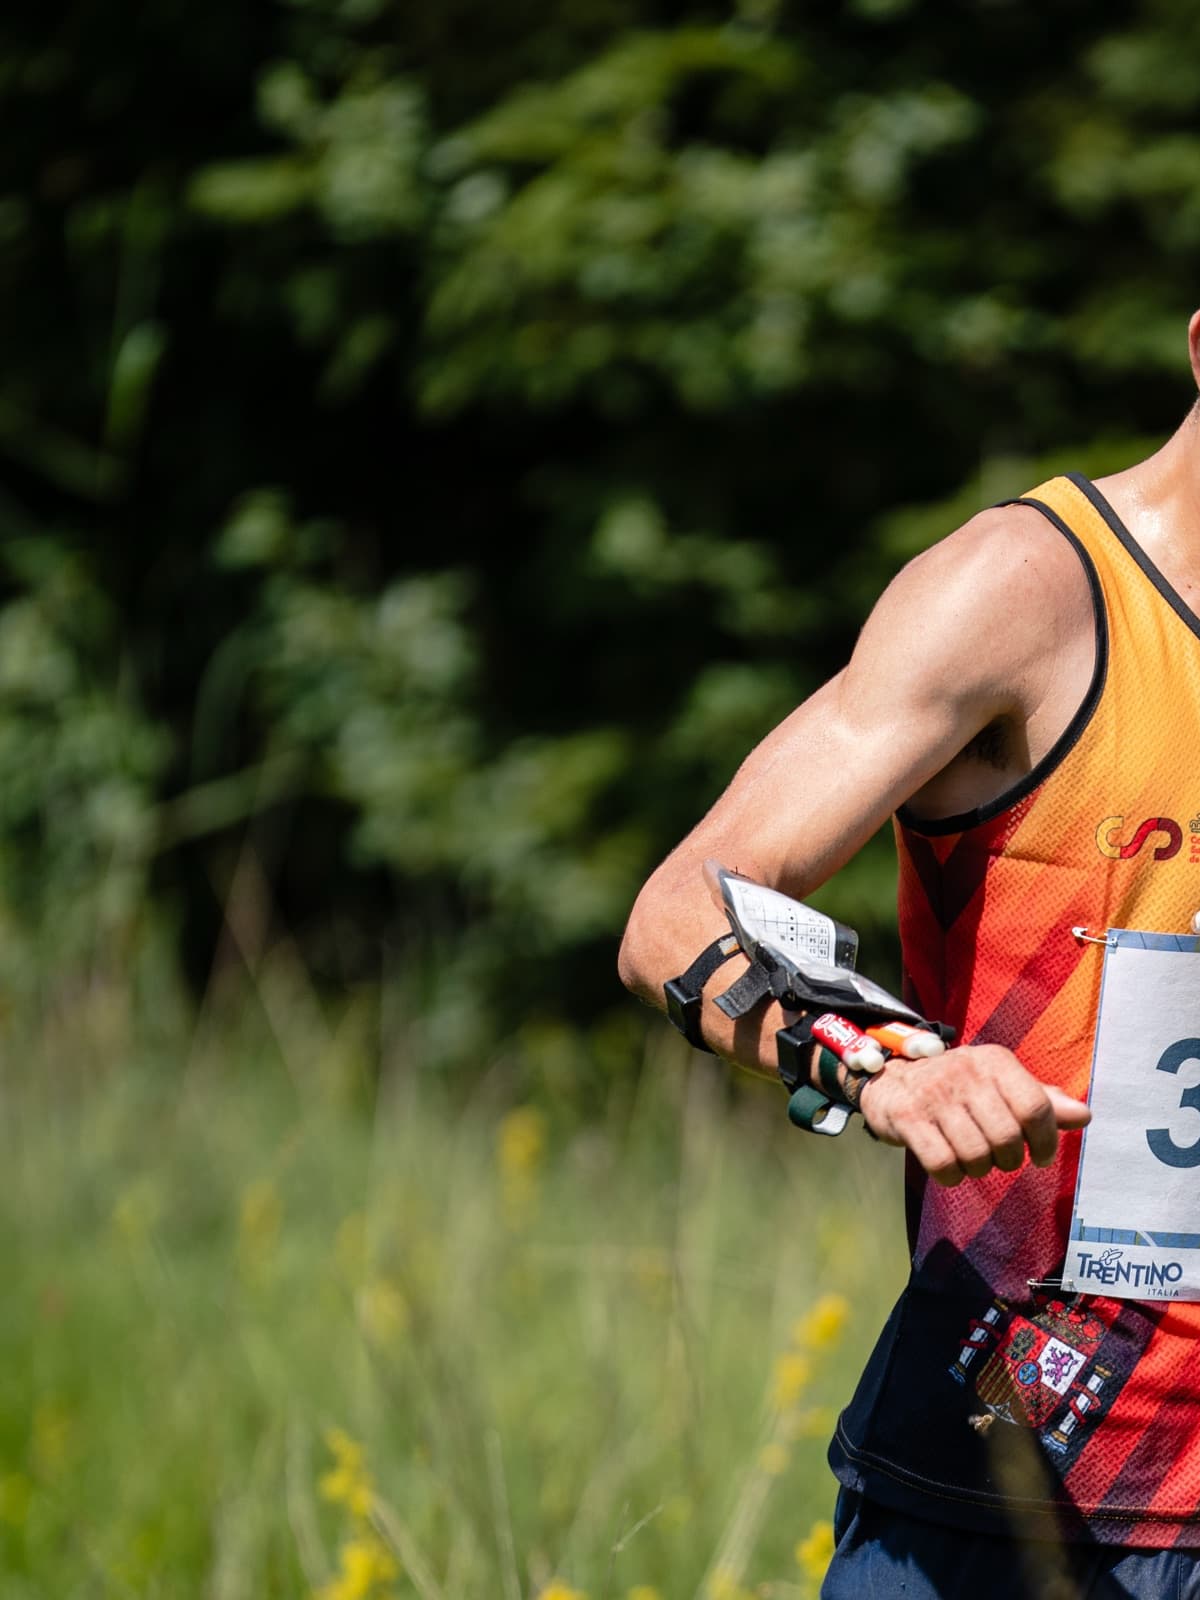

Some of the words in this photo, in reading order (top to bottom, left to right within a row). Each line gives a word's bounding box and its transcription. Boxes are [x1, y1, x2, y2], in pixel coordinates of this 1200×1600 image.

[1189, 856, 1200, 864] de
[1077, 1252, 1183, 1287] TRENTINO
[1147, 1287, 1180, 1297] ITALIA
